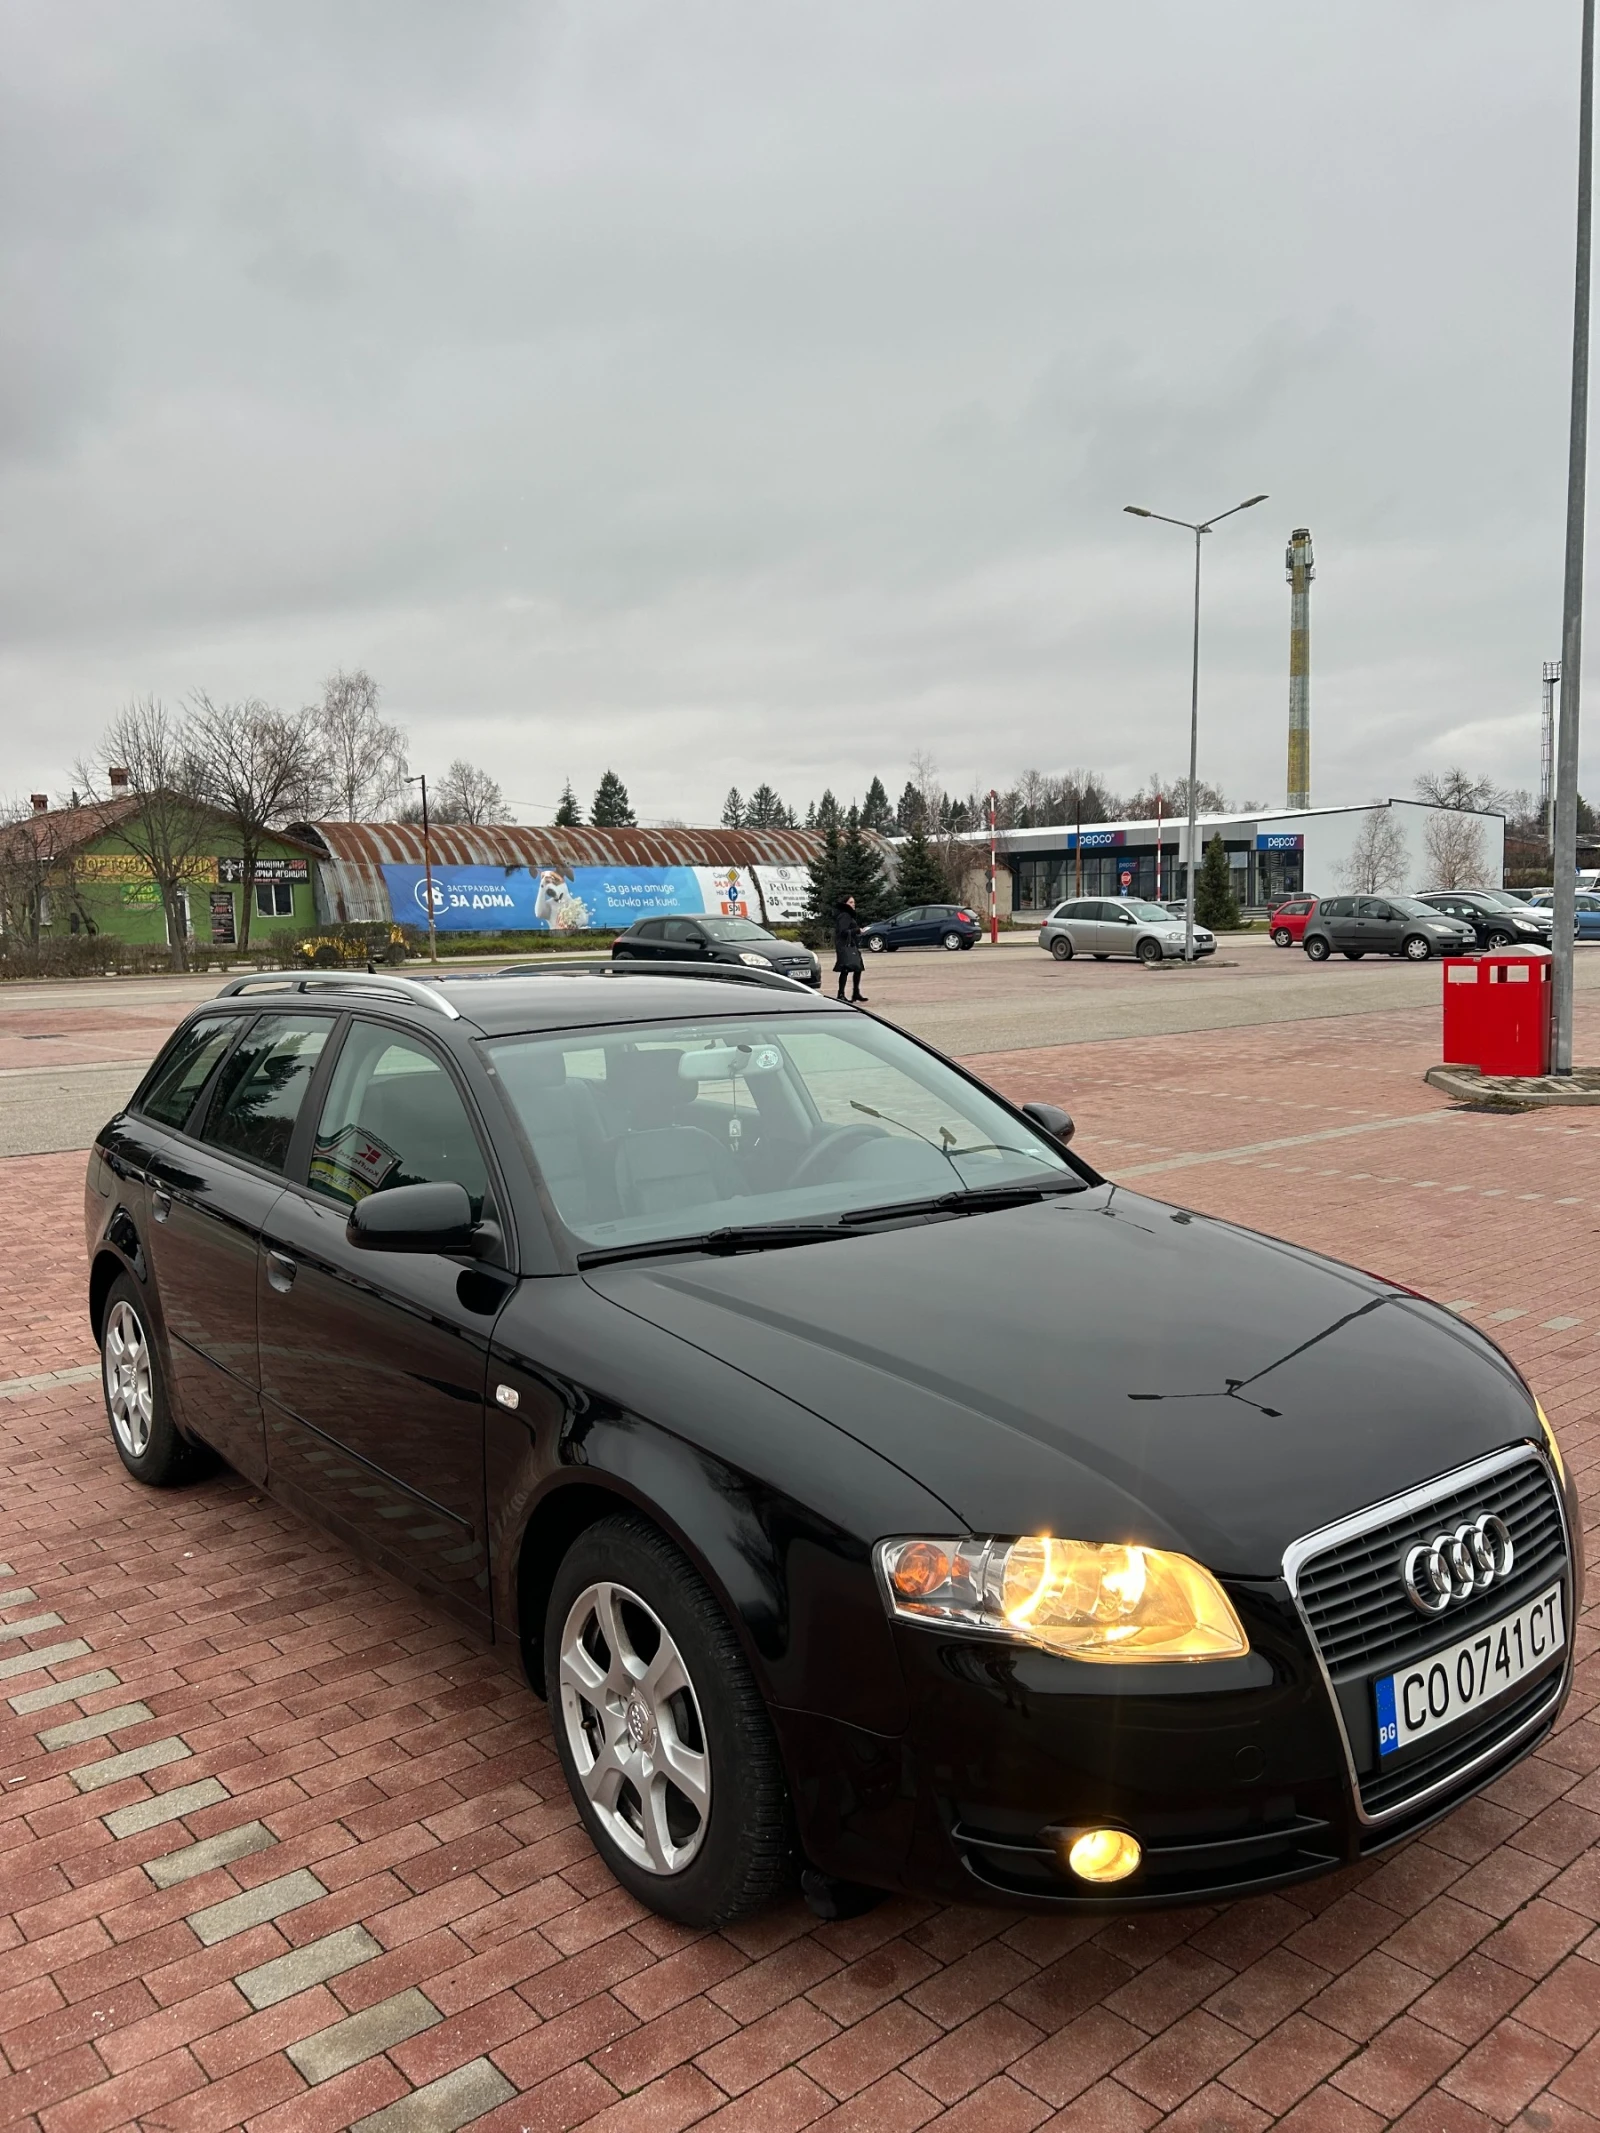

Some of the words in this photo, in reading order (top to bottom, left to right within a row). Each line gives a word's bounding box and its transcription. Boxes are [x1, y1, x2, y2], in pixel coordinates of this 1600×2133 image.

[1268, 837, 1295, 848] pepco
[446, 885, 507, 893] ЗАСТРАХОВКА
[603, 883, 617, 893] За
[618, 884, 630, 895] да
[630, 884, 643, 893] не
[644, 884, 675, 895] отиде
[449, 894, 470, 907] ЗА
[472, 894, 515, 909] ДОМА
[643, 898, 655, 907] на
[1402, 1662, 1450, 1731] CO
[1456, 1617, 1525, 1704] 0741
[1529, 1591, 1558, 1658] CT
[1379, 1722, 1397, 1745] BG
